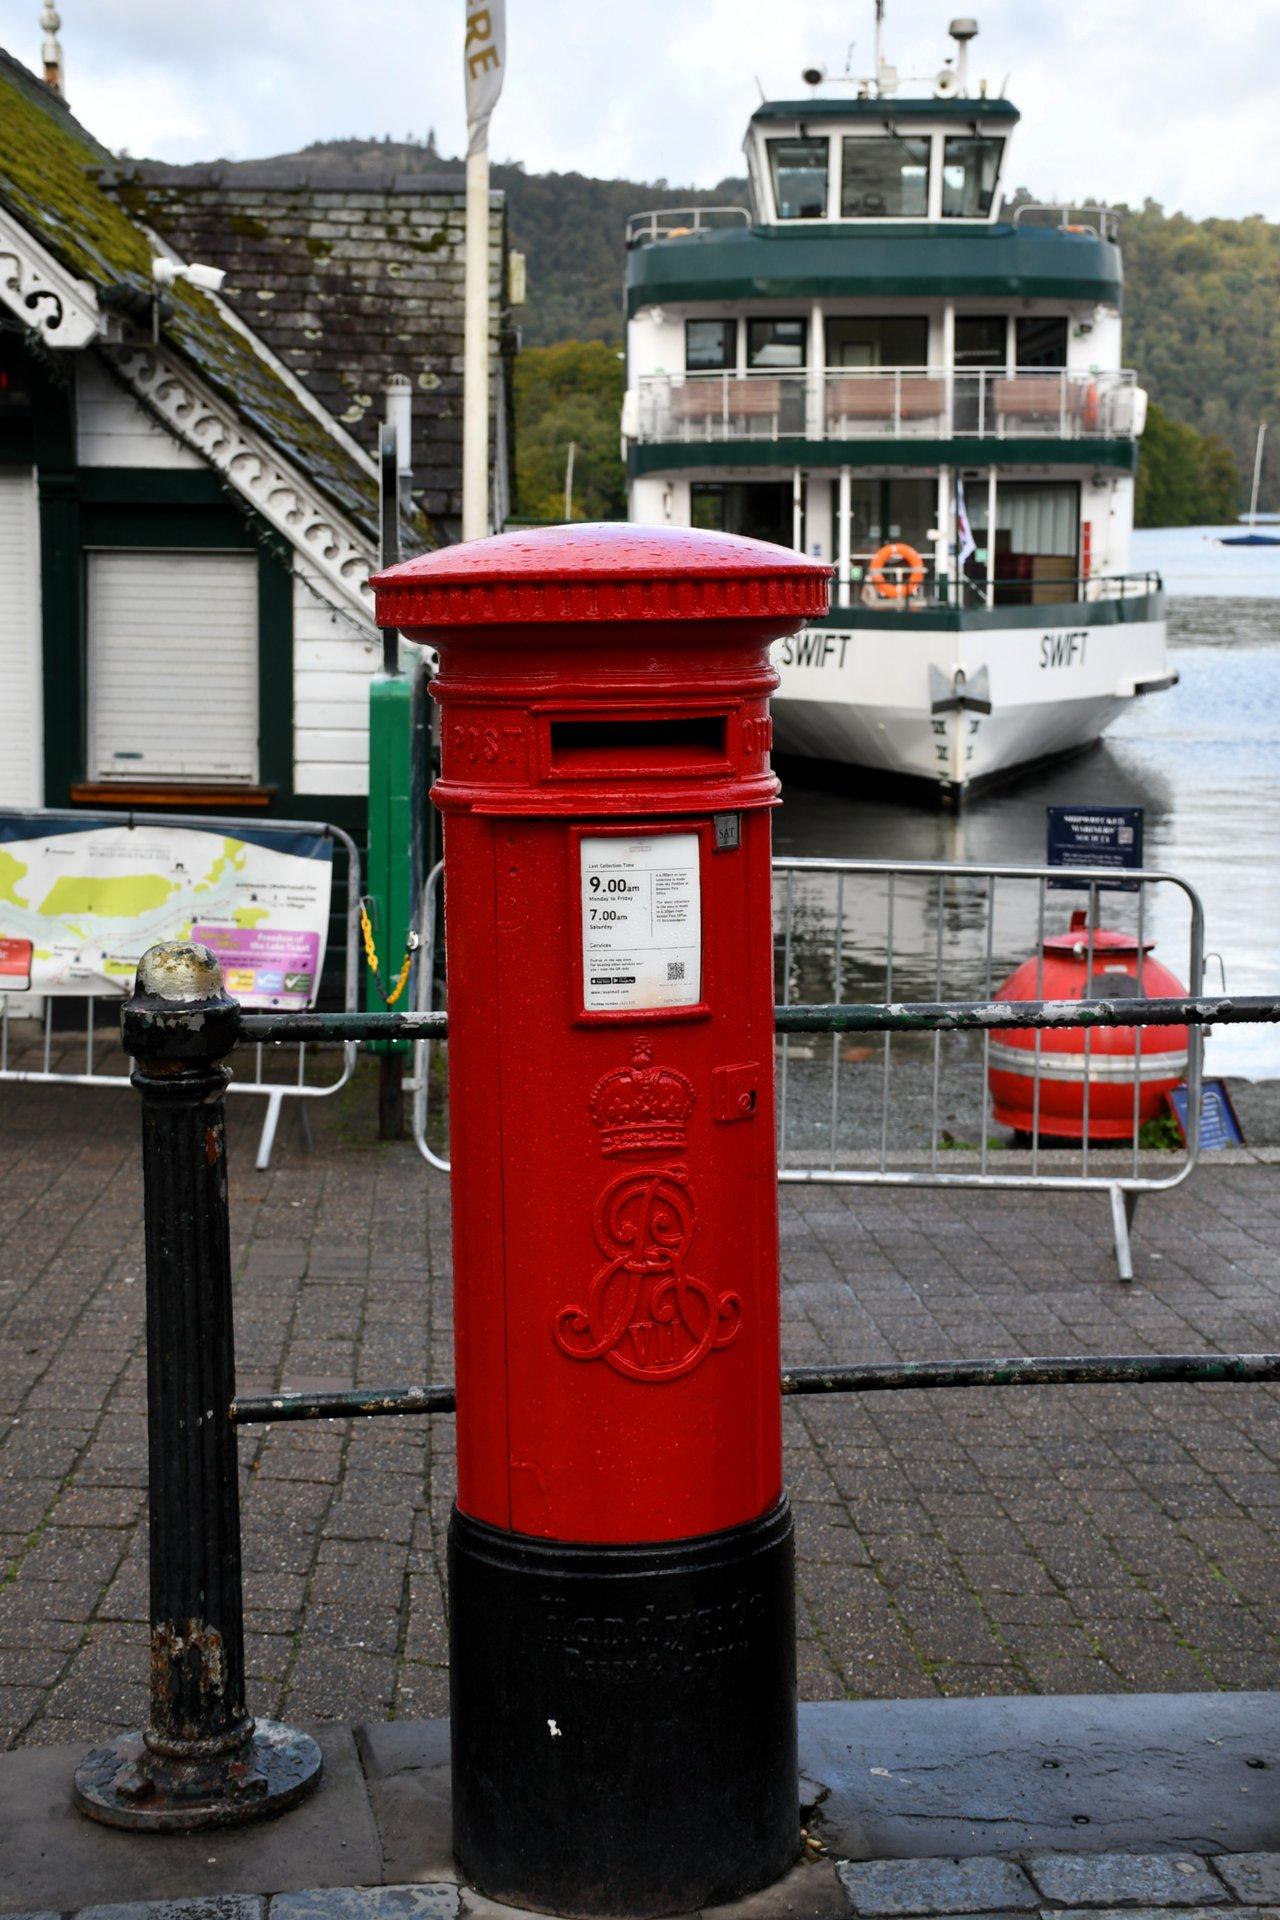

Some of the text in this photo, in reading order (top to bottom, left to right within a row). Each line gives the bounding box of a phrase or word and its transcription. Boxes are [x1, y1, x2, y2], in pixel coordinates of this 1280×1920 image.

[465, 0, 500, 80] RE
[782, 634, 852, 668] SWIFT
[1040, 631, 1089, 669] SWIFT
[718, 827, 736, 840] SAT
[589, 876, 640, 893] 9.00am
[589, 909, 628, 921] 7.00am
